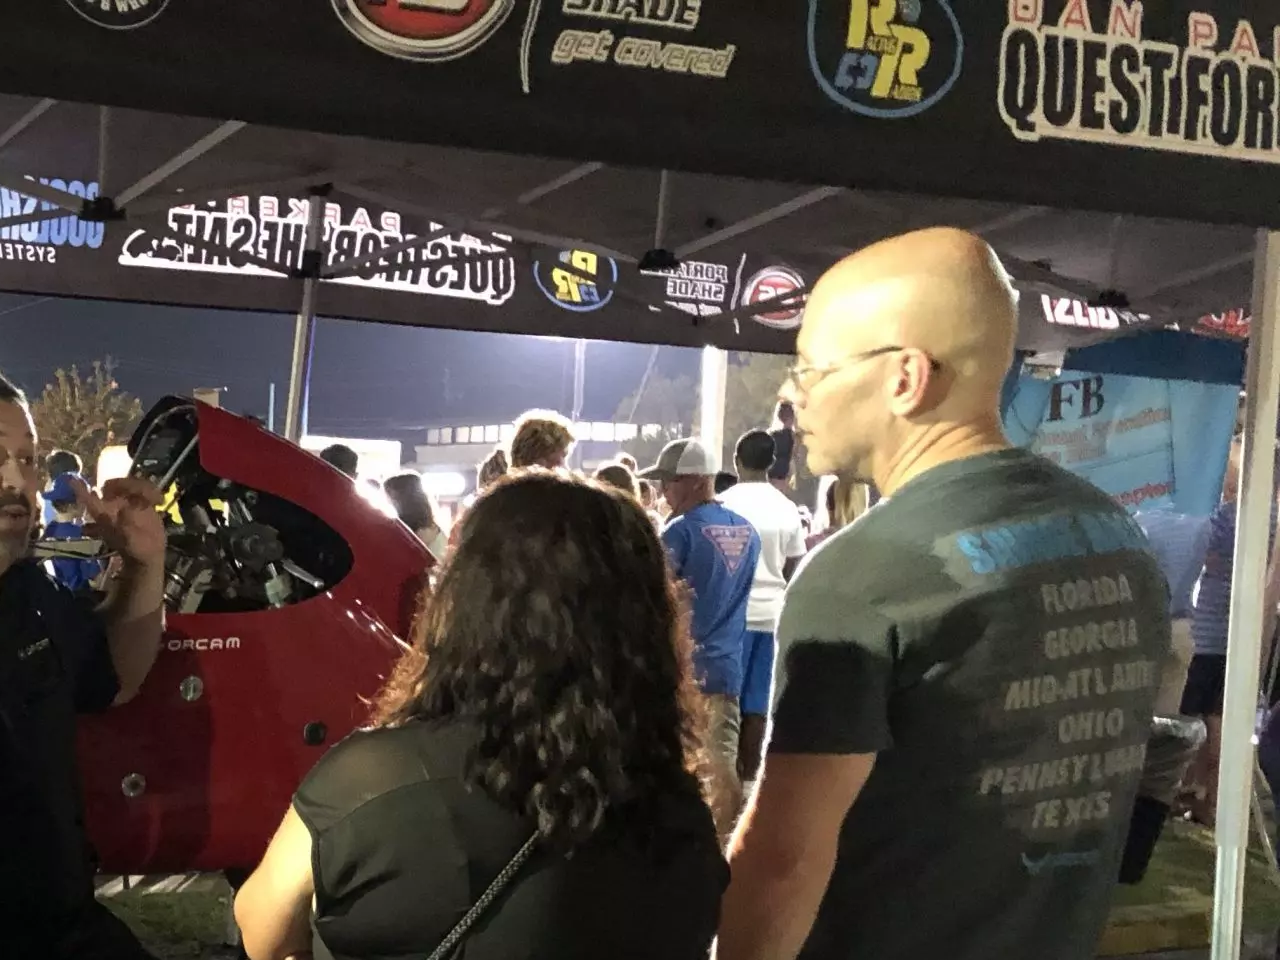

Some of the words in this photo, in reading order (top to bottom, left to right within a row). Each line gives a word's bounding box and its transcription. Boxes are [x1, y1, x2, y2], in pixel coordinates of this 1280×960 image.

[552, 30, 614, 63] get
[615, 37, 736, 77] covered
[1188, 12, 1280, 60] PA
[1000, 27, 1177, 140] QUEST
[1041, 575, 1133, 613] FLORIDA
[1045, 619, 1138, 659] GEORGIA
[1058, 708, 1125, 743] OHIO
[1032, 792, 1112, 829] TEXAS
